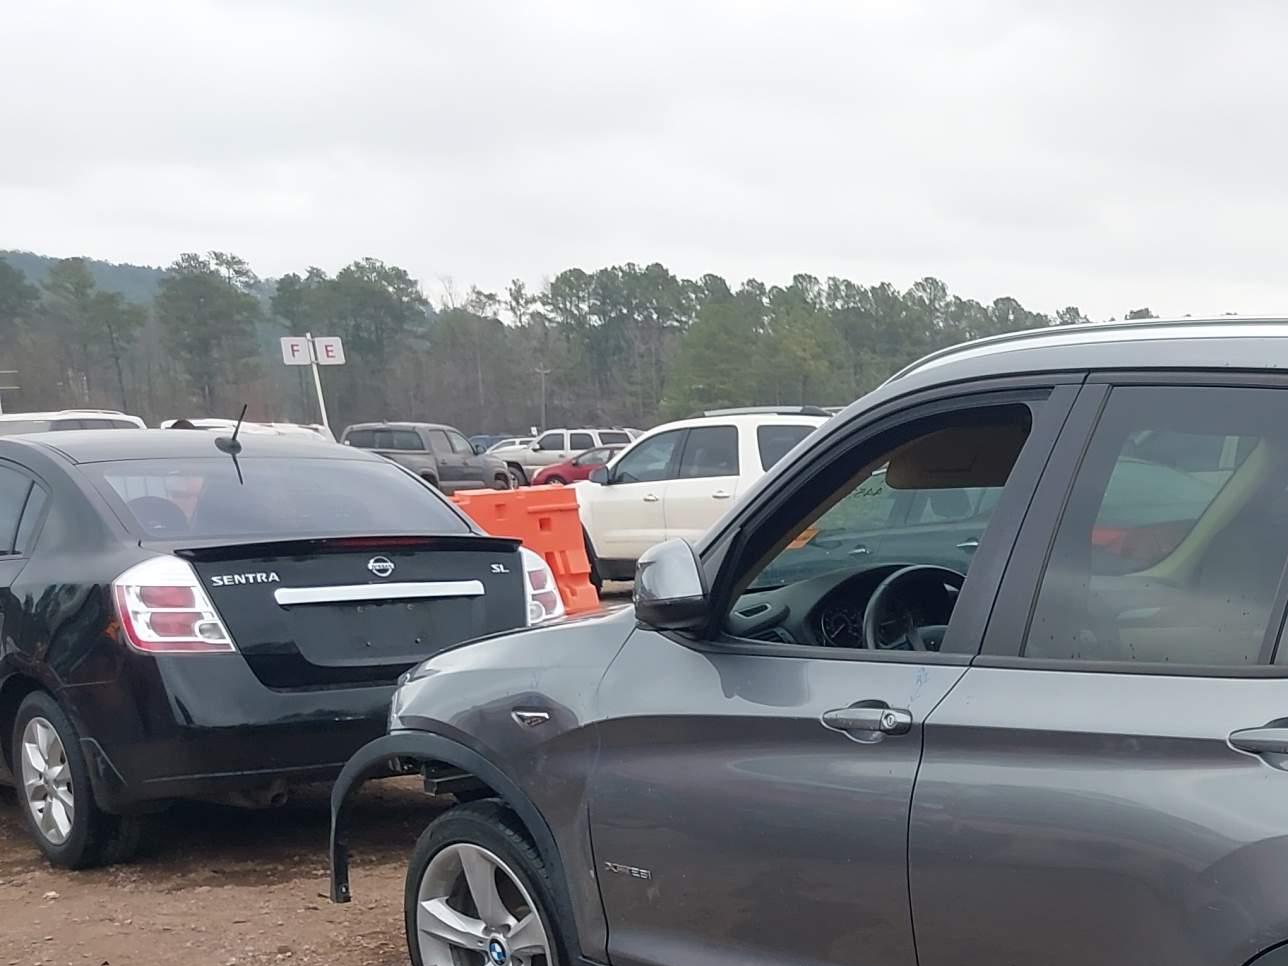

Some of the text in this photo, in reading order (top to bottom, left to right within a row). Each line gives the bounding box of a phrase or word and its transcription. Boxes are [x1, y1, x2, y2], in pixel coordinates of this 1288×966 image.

[290, 344, 300, 358] F
[324, 344, 336, 358] E
[490, 563, 510, 573] SL
[210, 572, 281, 587] SENTRA
